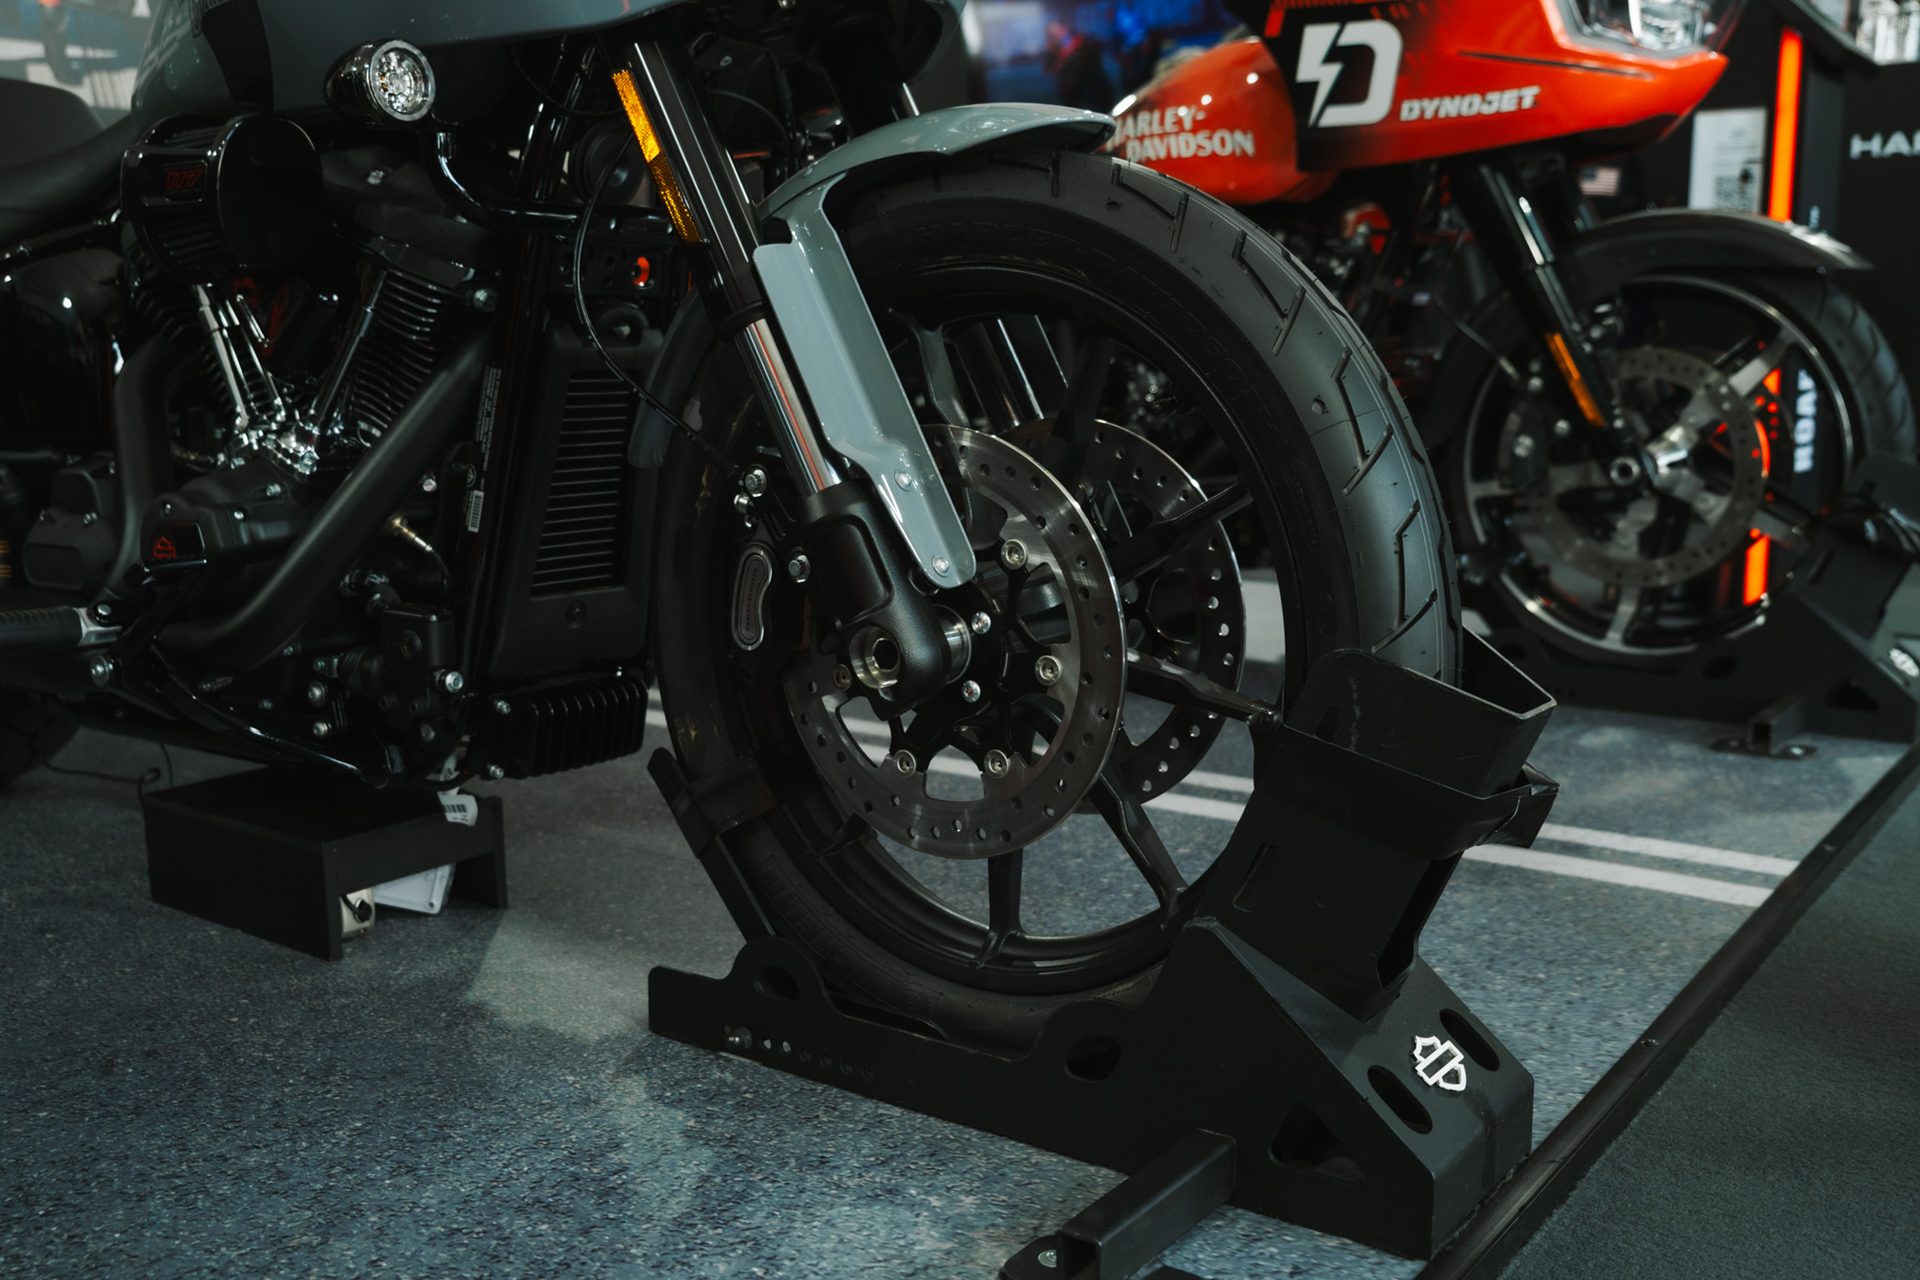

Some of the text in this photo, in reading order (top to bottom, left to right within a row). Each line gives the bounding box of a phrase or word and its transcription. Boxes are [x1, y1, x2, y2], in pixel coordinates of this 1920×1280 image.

[1399, 86, 1541, 122] DYNOJET
[1126, 128, 1256, 163] DAVIDSON
[1850, 131, 1920, 159] HA
